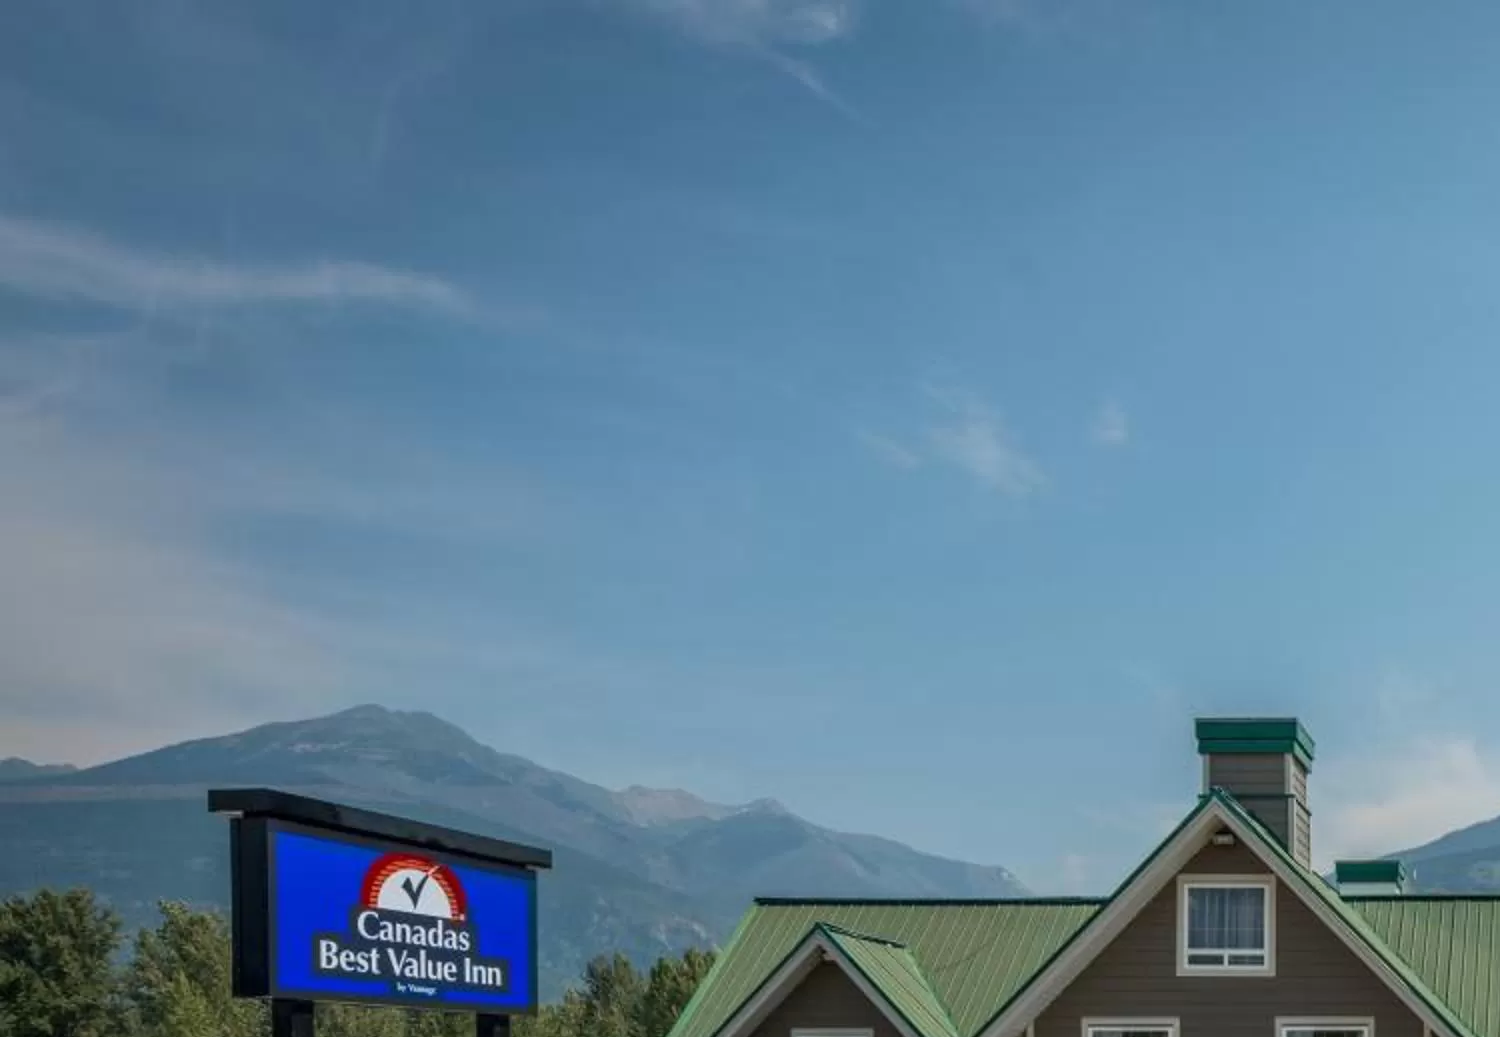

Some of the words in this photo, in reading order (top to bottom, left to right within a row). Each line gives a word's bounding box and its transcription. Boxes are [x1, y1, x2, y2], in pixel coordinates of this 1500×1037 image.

[357, 911, 471, 952] Canadas
[319, 939, 382, 975] Best
[387, 948, 458, 982] Value
[464, 957, 503, 987] Inn
